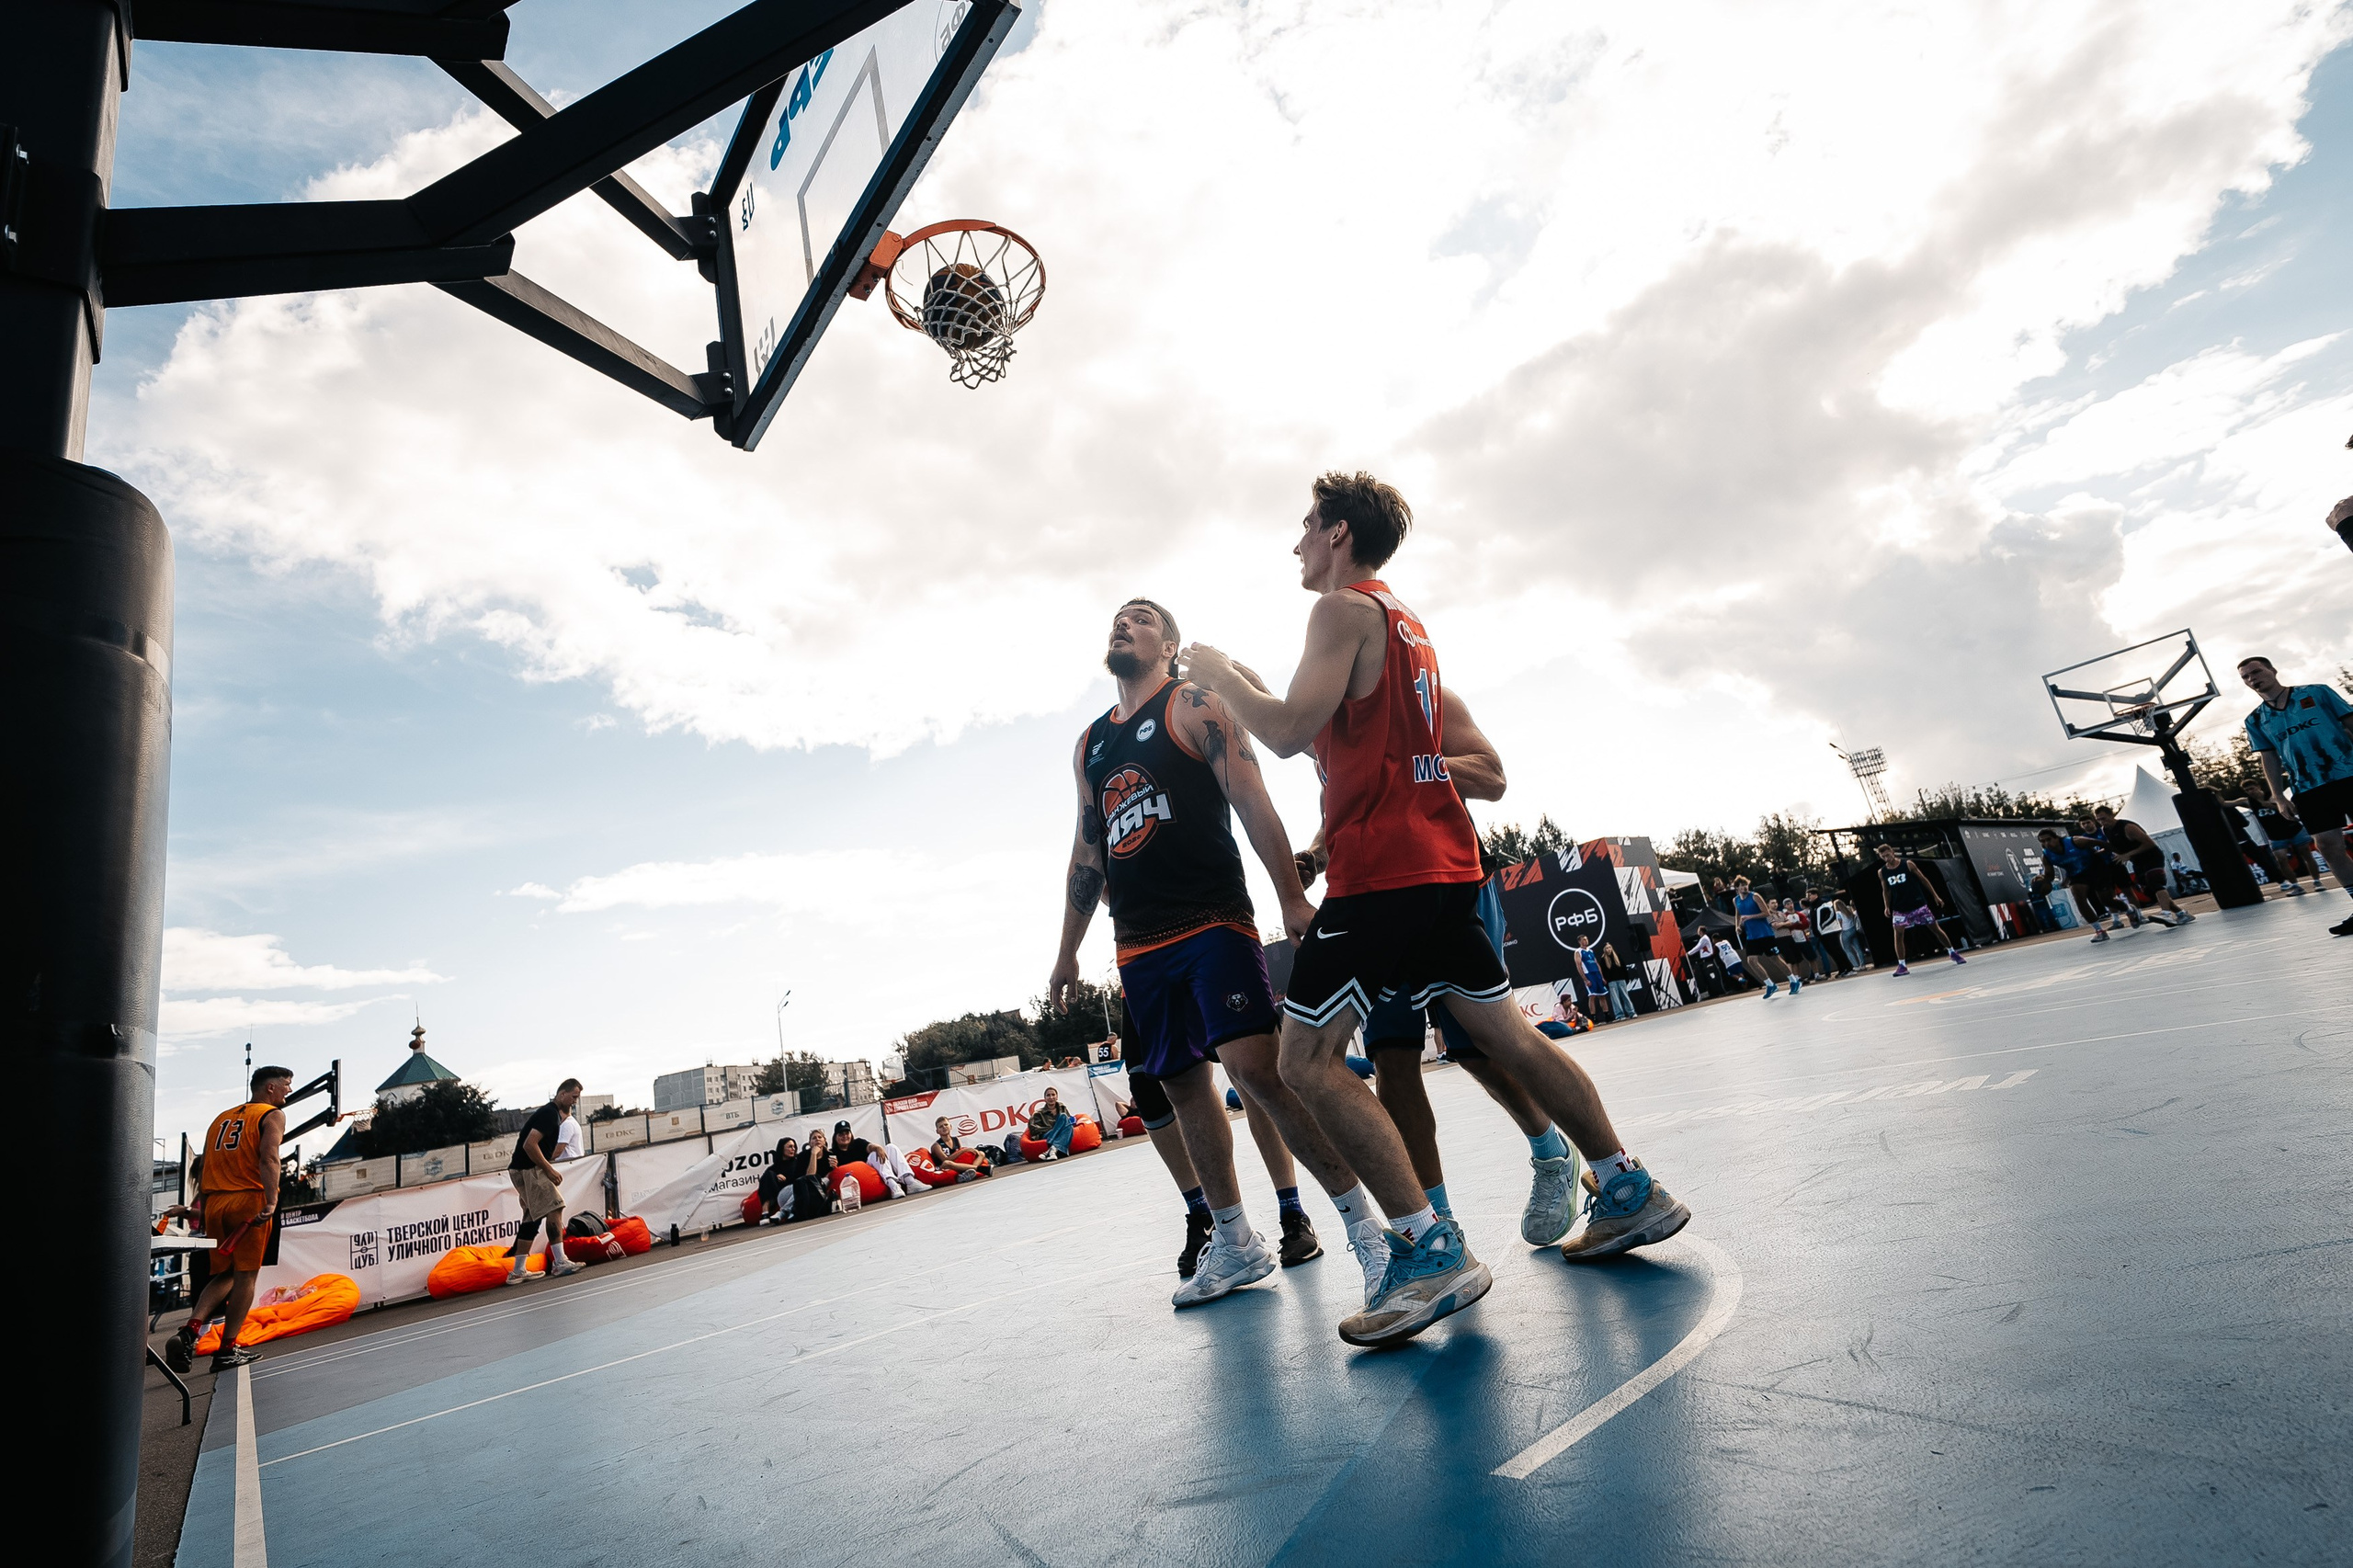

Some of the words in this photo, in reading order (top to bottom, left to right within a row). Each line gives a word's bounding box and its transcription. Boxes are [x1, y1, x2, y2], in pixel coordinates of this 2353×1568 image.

[2287, 718, 2320, 735] DKC
[1107, 793, 1172, 858] МЯЧ
[1554, 908, 1598, 932] РФБ
[1519, 1003, 1543, 1018] KC
[1098, 1047, 1109, 1058] 55
[725, 1111, 740, 1119] ВТБ
[215, 1119, 244, 1152] 13
[615, 1129, 635, 1138] DKC
[387, 1214, 449, 1244] ТВЕРСКОЙ
[453, 1210, 489, 1232] ЦЕНТР
[387, 1233, 450, 1263] УЛИЧНОГО
[454, 1220, 521, 1248] БАСКЕТБОЛ
[354, 1254, 376, 1269] ЦУБ
